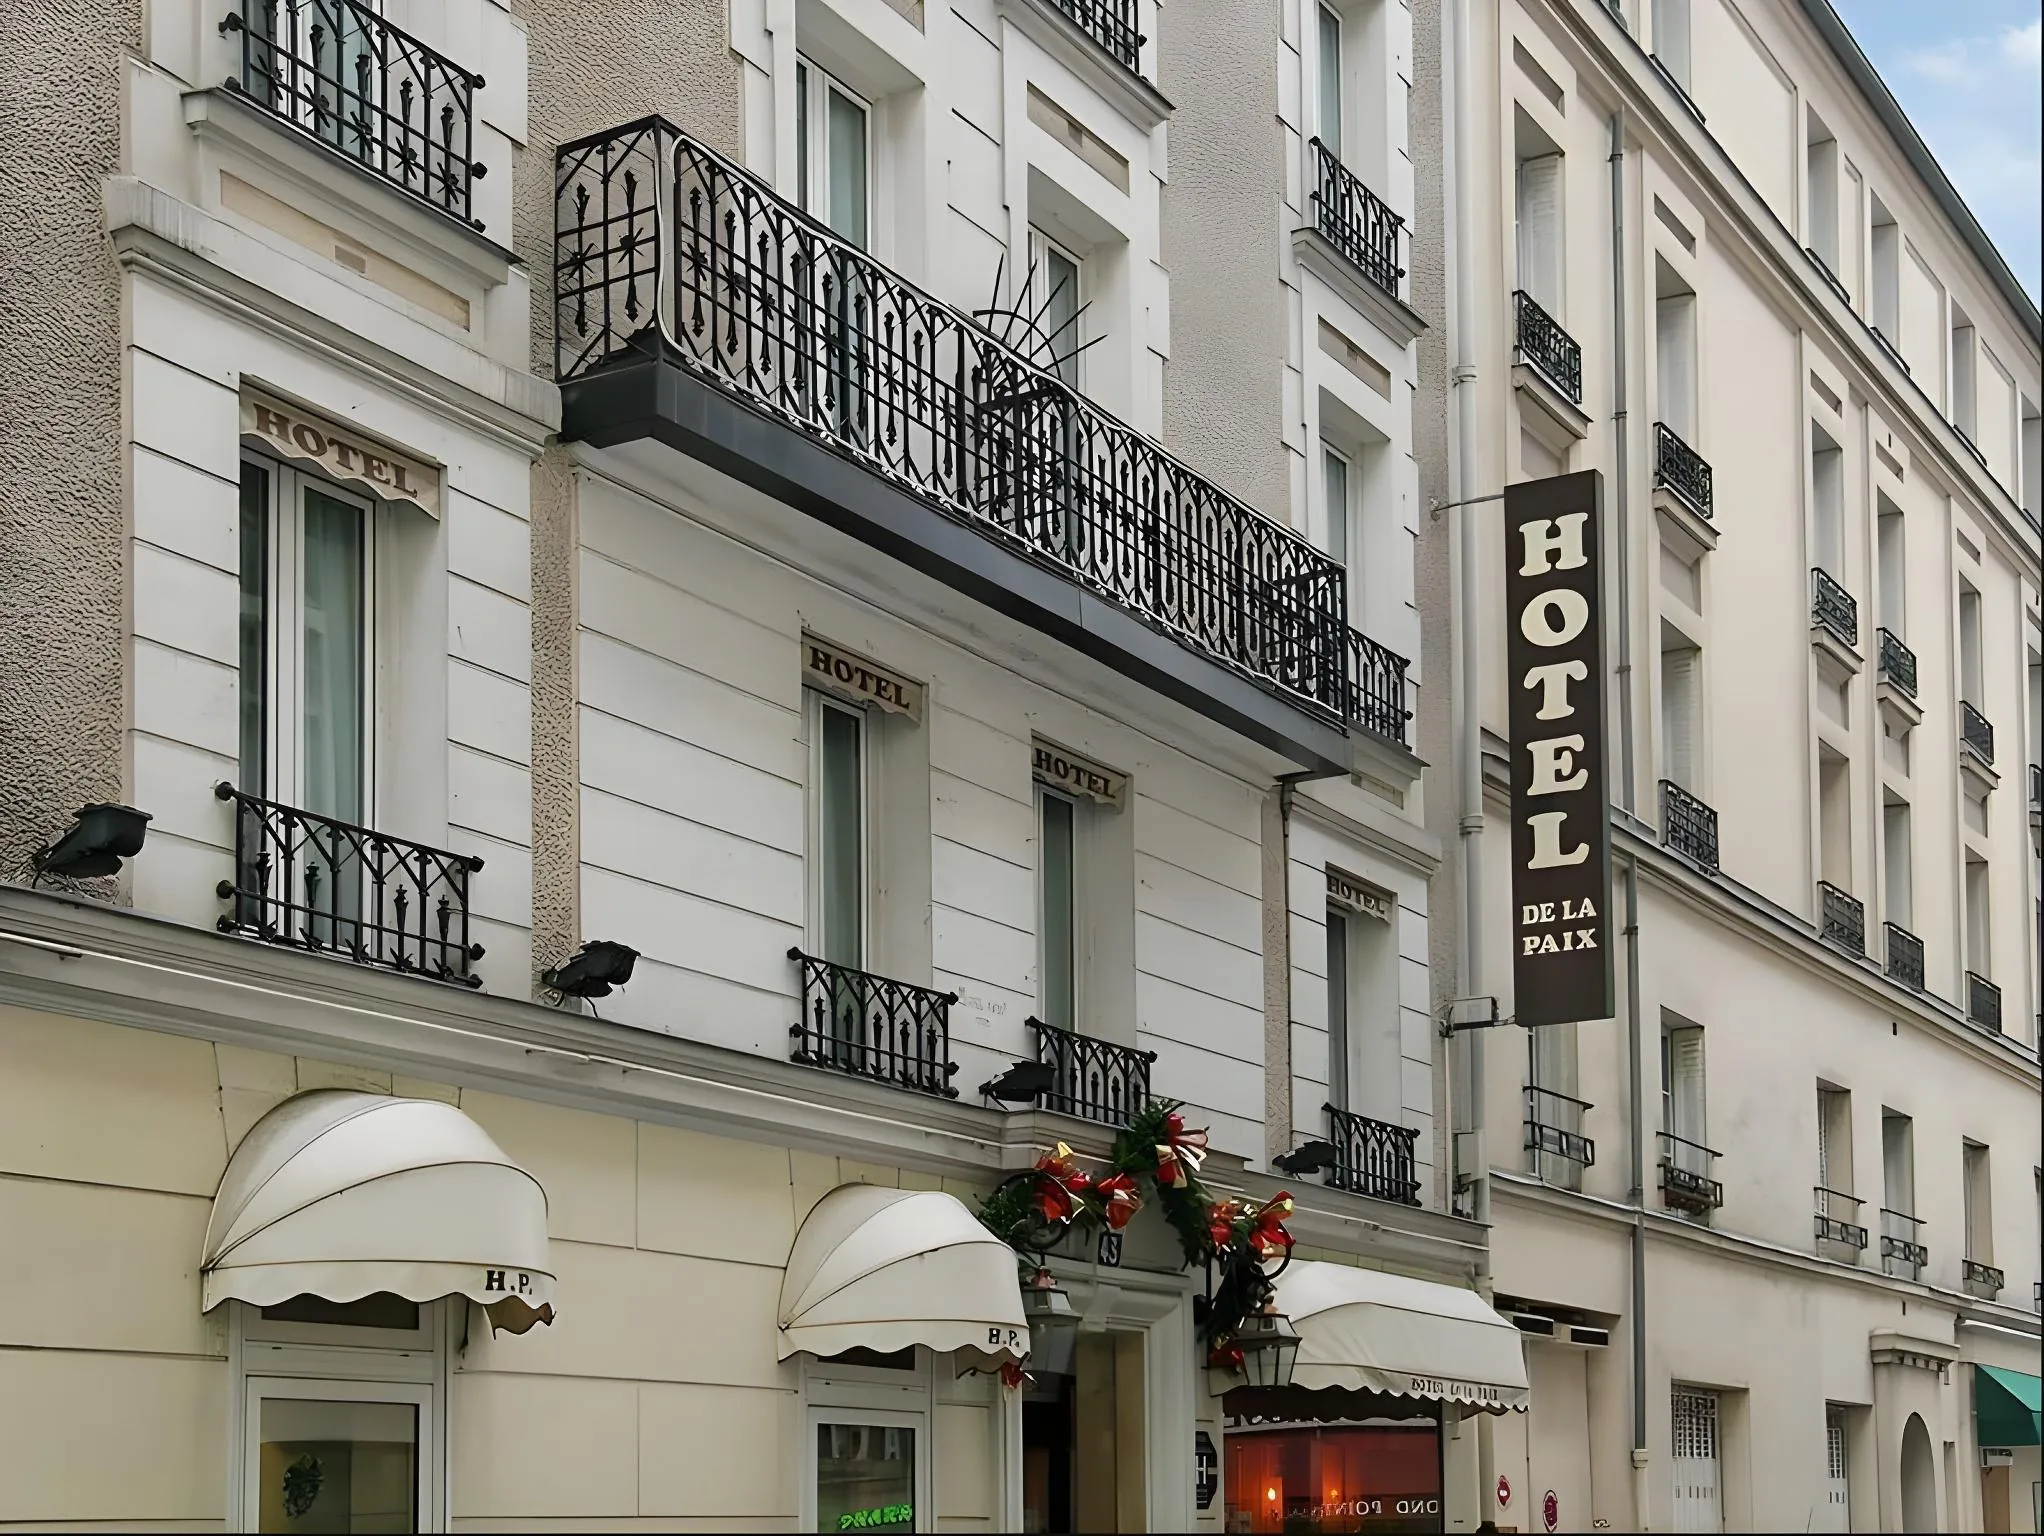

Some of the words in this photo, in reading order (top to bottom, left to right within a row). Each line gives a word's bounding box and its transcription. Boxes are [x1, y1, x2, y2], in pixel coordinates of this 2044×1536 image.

[253, 403, 418, 498] HOTEL
[809, 646, 910, 709] HOTEL
[1518, 512, 1590, 870] HOTEL
[1033, 747, 1117, 799] HOTEL
[1326, 874, 1385, 914] HOTEL
[1522, 902, 1556, 925] DE
[1562, 897, 1597, 920] LA
[1523, 928, 1598, 956] PAIX
